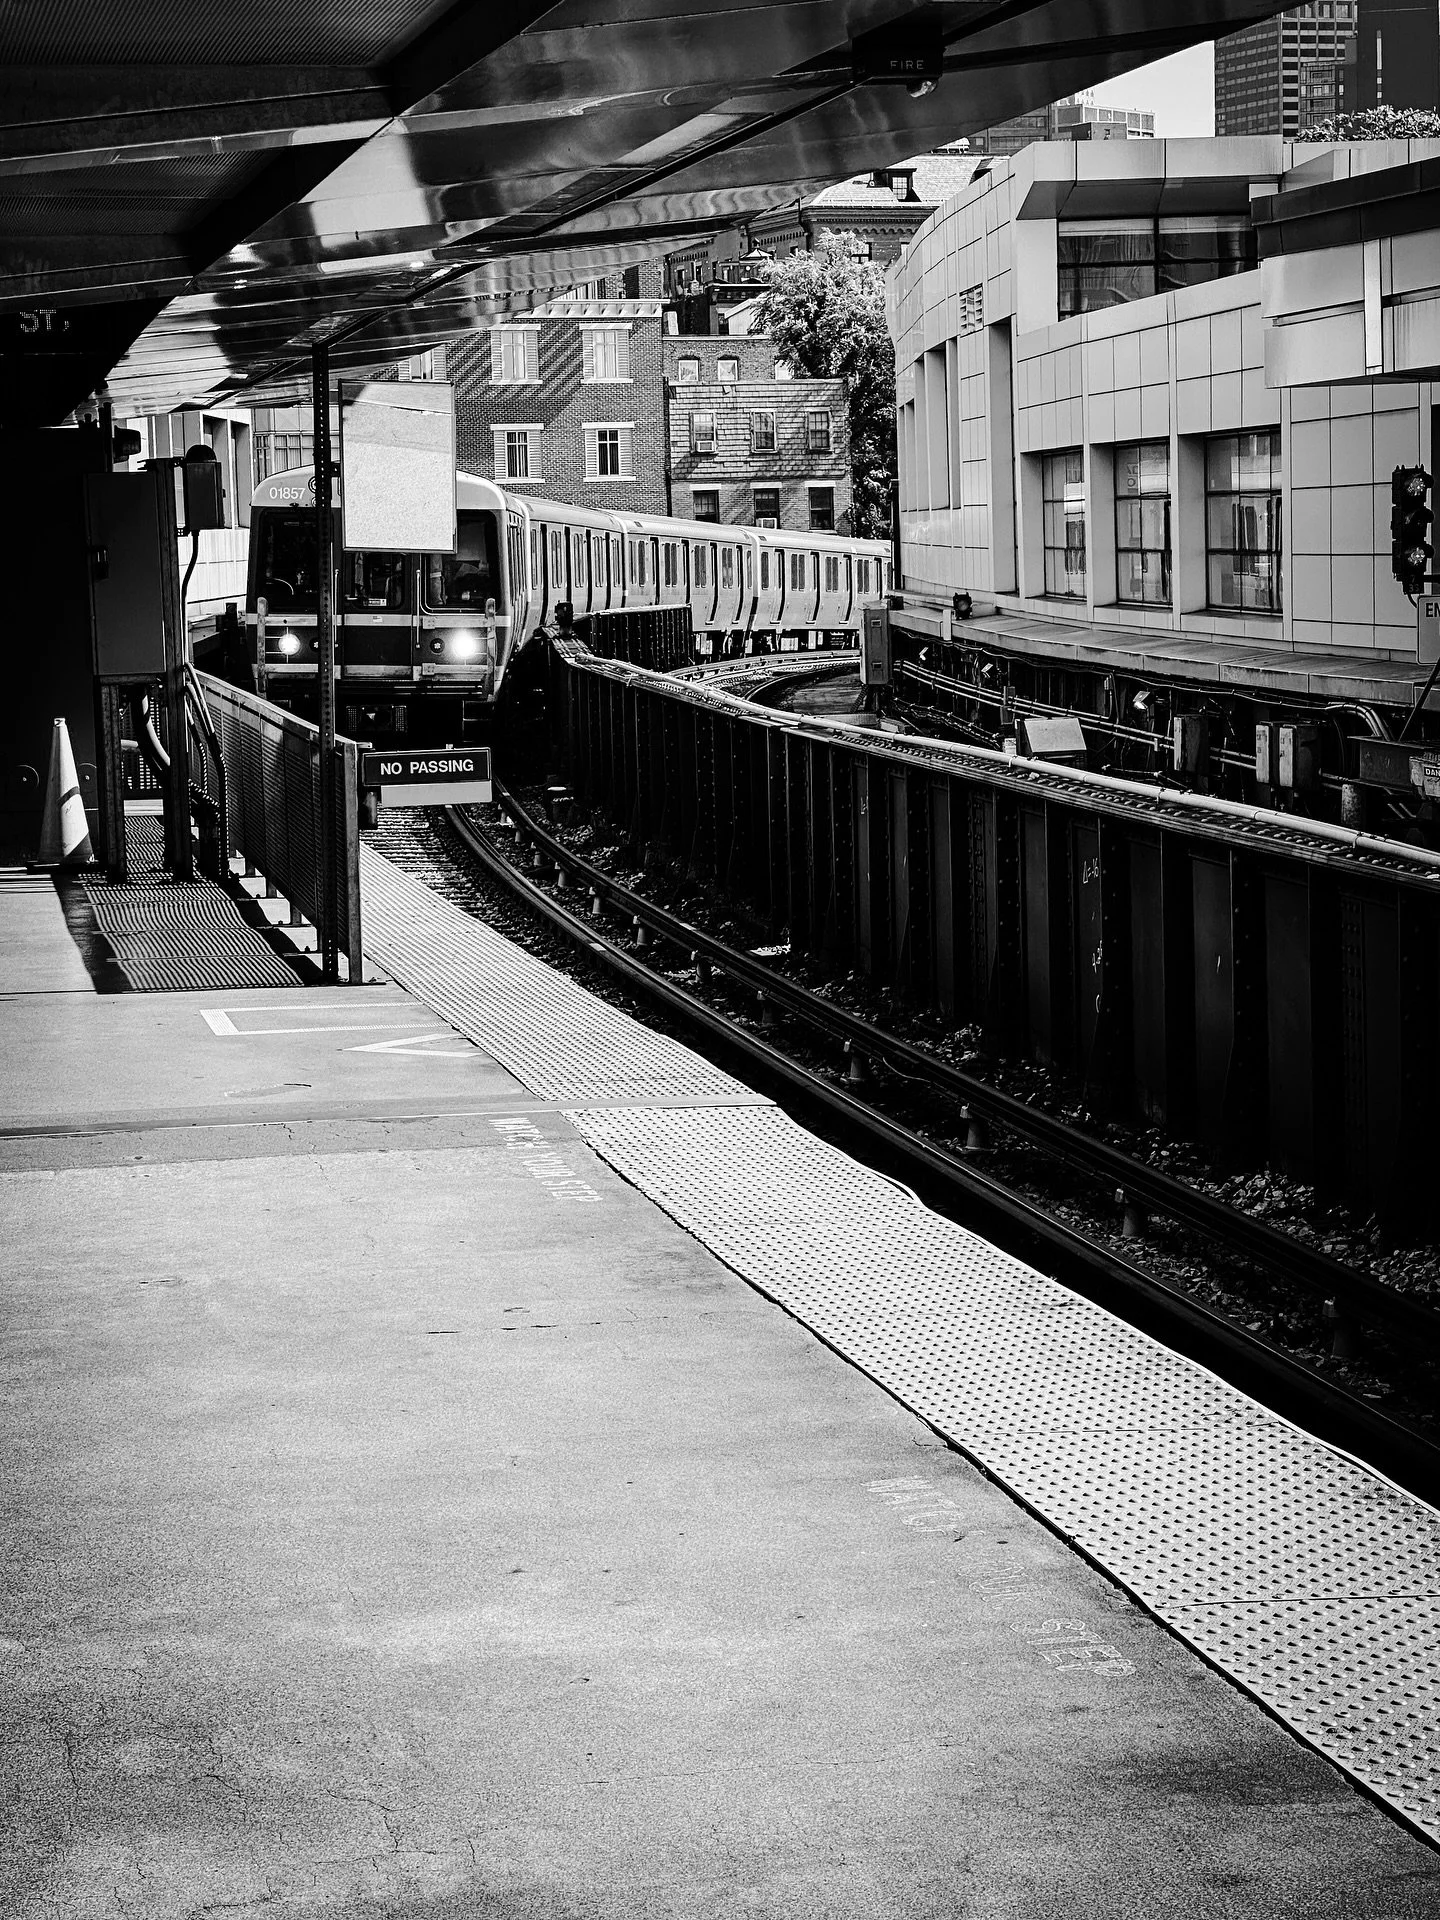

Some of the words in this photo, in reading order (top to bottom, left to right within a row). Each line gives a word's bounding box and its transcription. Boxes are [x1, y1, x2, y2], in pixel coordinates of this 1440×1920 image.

[890, 59, 925, 70] FIRE
[269, 487, 306, 500] 01857
[380, 762, 403, 775] NO
[409, 759, 474, 774] PASSING
[541, 1179, 604, 1202] STEP
[1009, 1617, 1137, 1677] STEP
